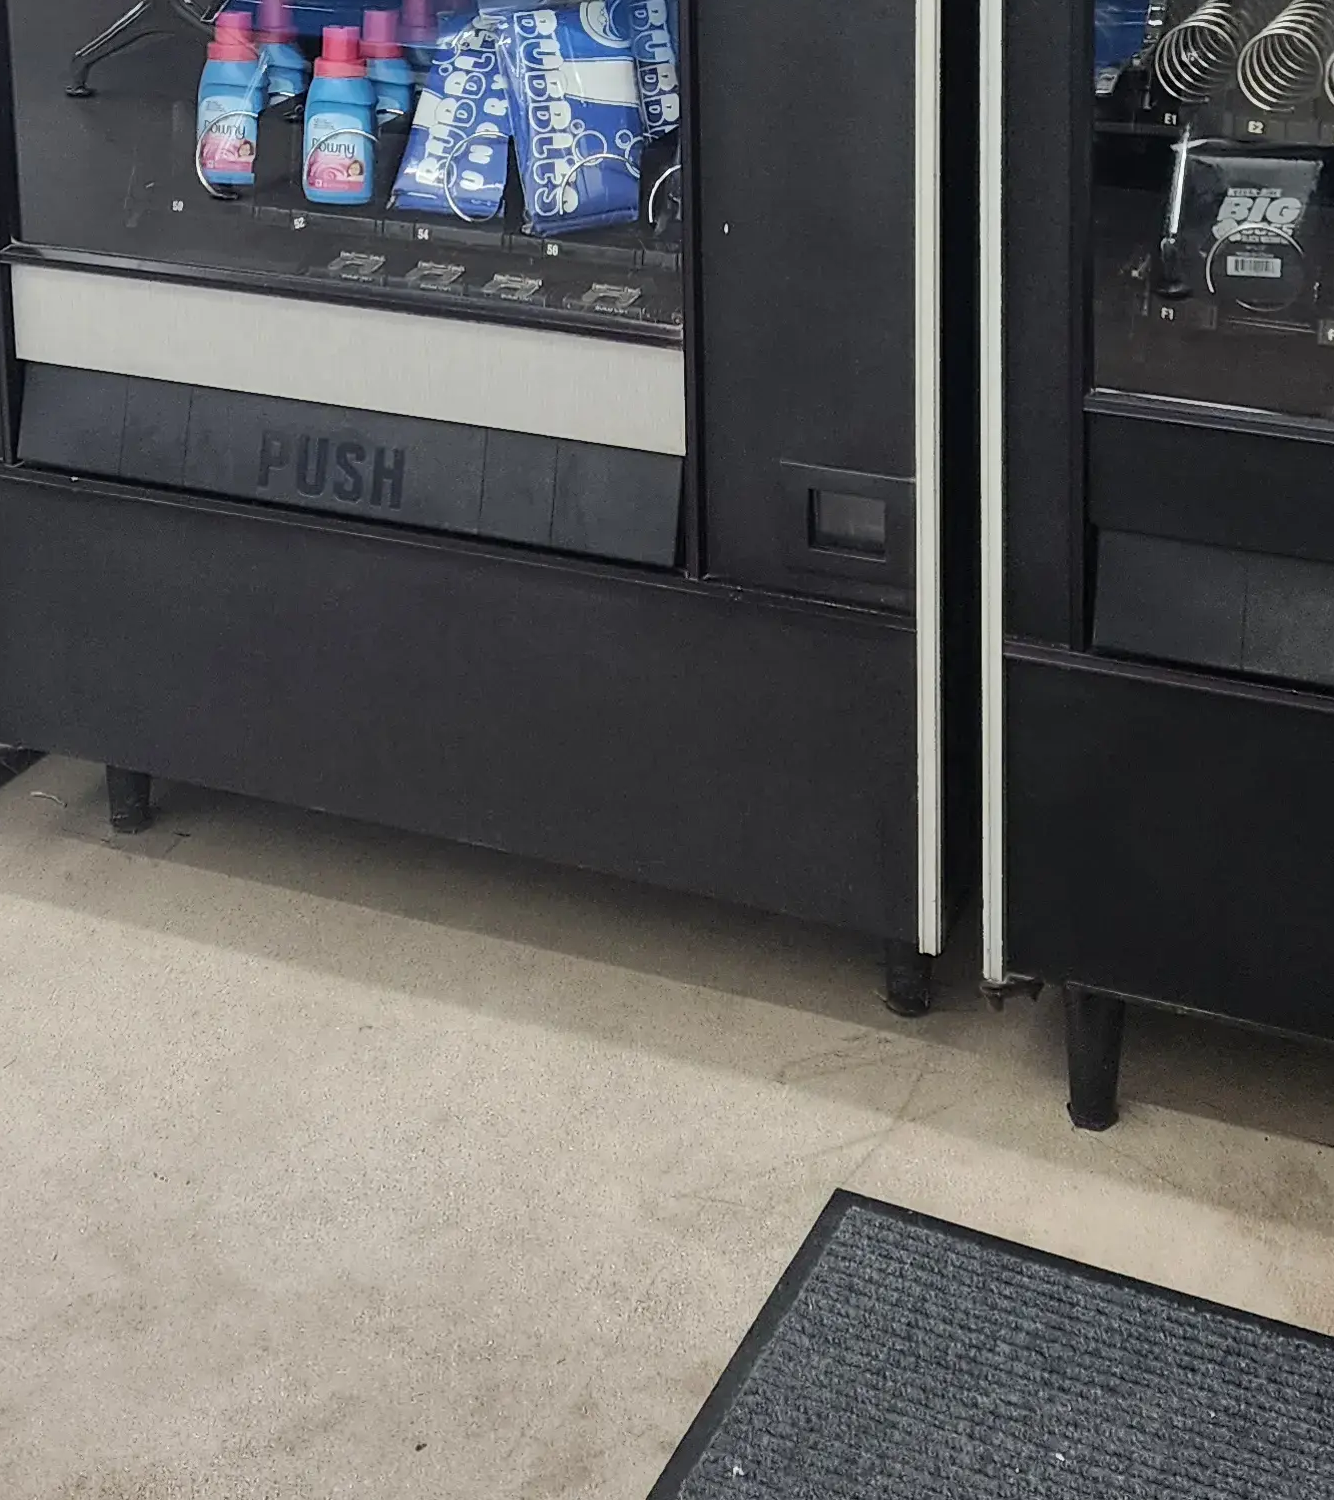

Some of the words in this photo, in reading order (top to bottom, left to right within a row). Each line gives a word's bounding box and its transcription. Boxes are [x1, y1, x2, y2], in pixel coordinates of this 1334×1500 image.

[513, 9, 578, 217] BUBBLES
[1164, 112, 1177, 125] E1
[1247, 120, 1264, 134] E2
[1217, 196, 1304, 224] BIG
[293, 217, 306, 230] 52
[417, 228, 429, 240] 54
[1160, 307, 1174, 320] F1
[258, 430, 406, 510] PUSH
